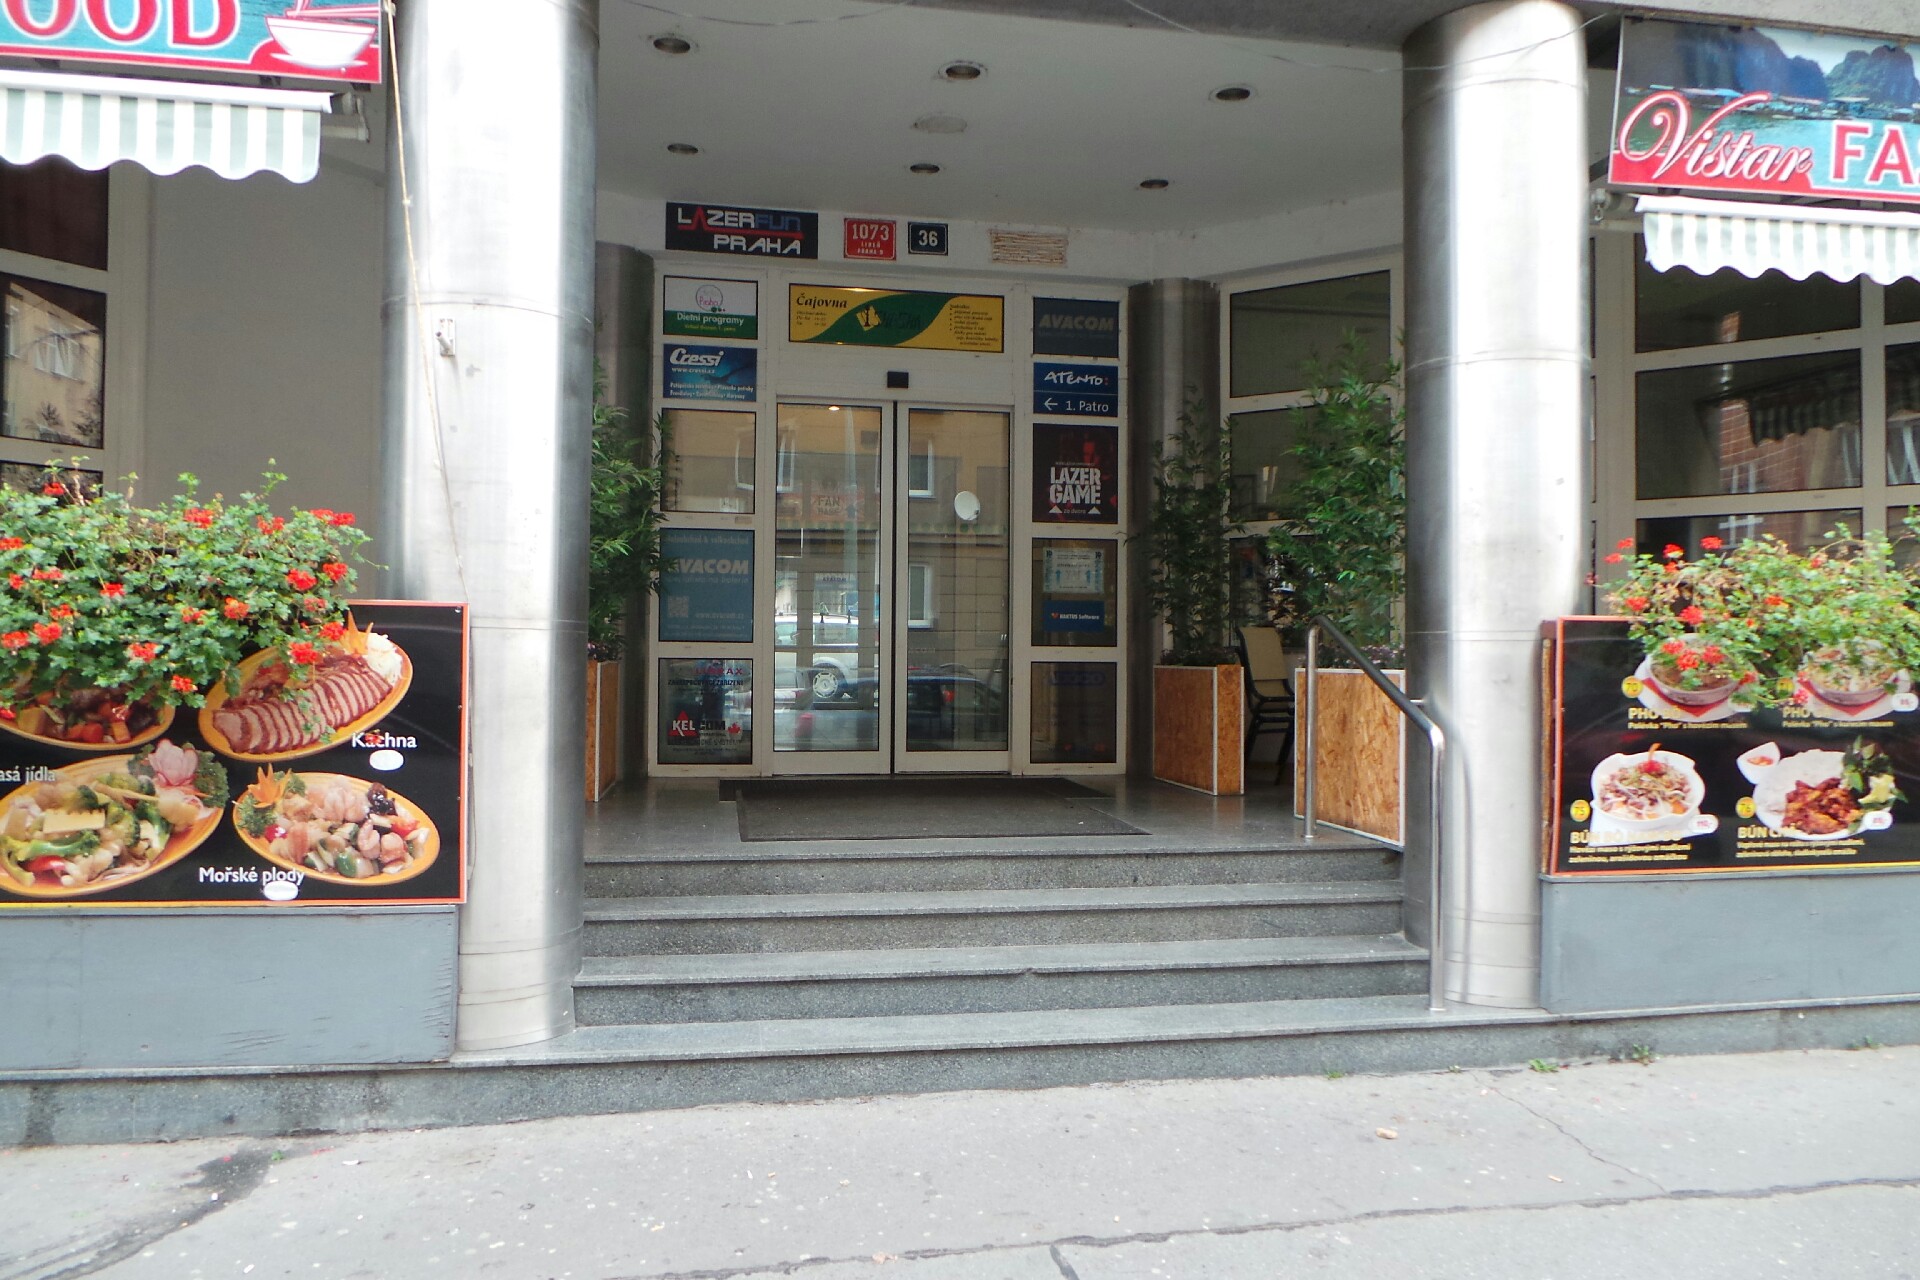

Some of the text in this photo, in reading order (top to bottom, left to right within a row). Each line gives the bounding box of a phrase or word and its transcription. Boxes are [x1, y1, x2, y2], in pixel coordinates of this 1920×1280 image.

[1617, 90, 1813, 181] Vistar
[852, 223, 889, 242] 1073
[918, 230, 939, 247] 36
[713, 234, 801, 255] PRAHA
[796, 292, 848, 309] Čajovna
[703, 314, 745, 326] programy
[1039, 313, 1114, 331] AVACOM
[669, 347, 725, 366] Cressi
[1066, 400, 1109, 412] 1. Patro
[1050, 466, 1102, 485] LAZER
[1050, 484, 1101, 505] GAME
[25, 765, 56, 785] jídla
[199, 866, 305, 886] Mořské plody
